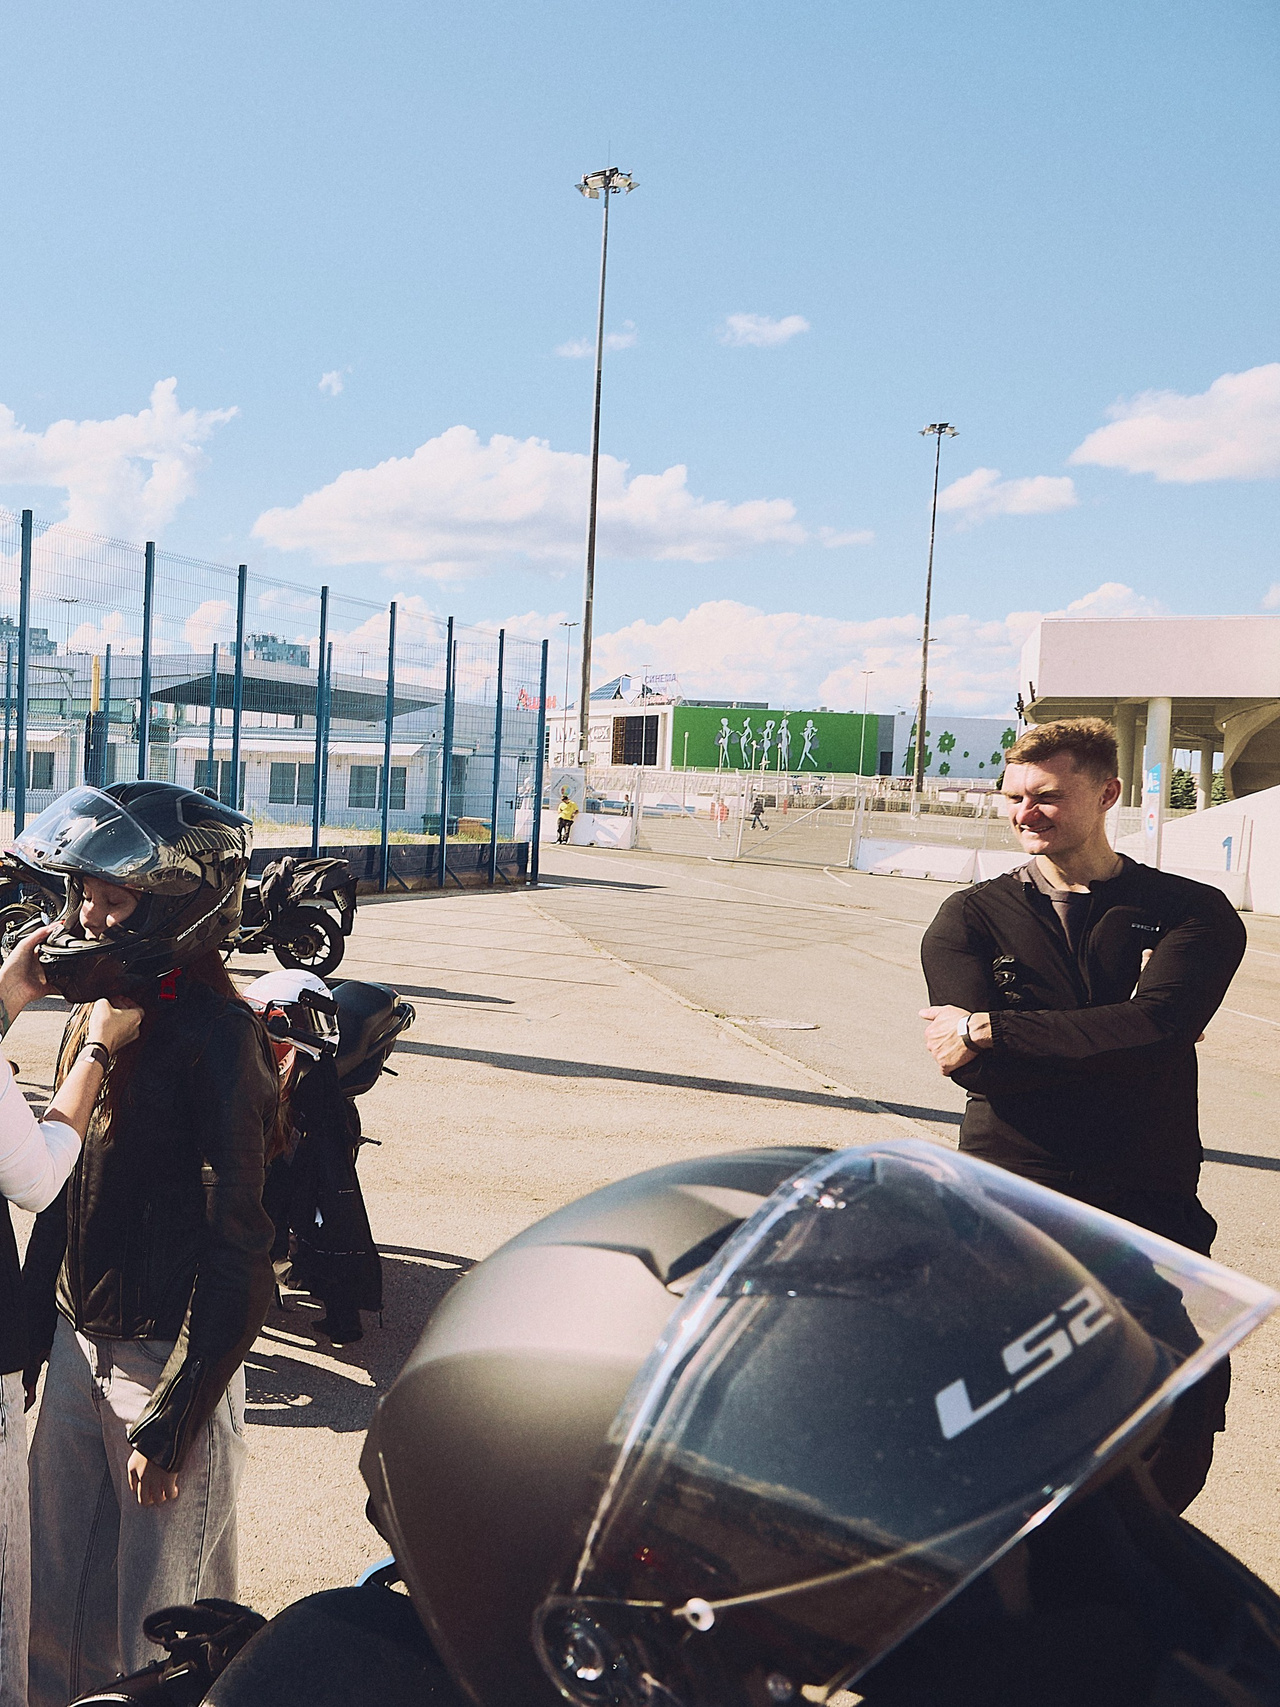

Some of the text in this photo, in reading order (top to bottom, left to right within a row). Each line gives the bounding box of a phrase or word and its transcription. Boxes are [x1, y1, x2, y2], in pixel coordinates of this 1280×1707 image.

[1222, 836, 1233, 871] 1
[176, 902, 222, 942] SCORPION
[934, 1285, 1115, 1440] LS2
